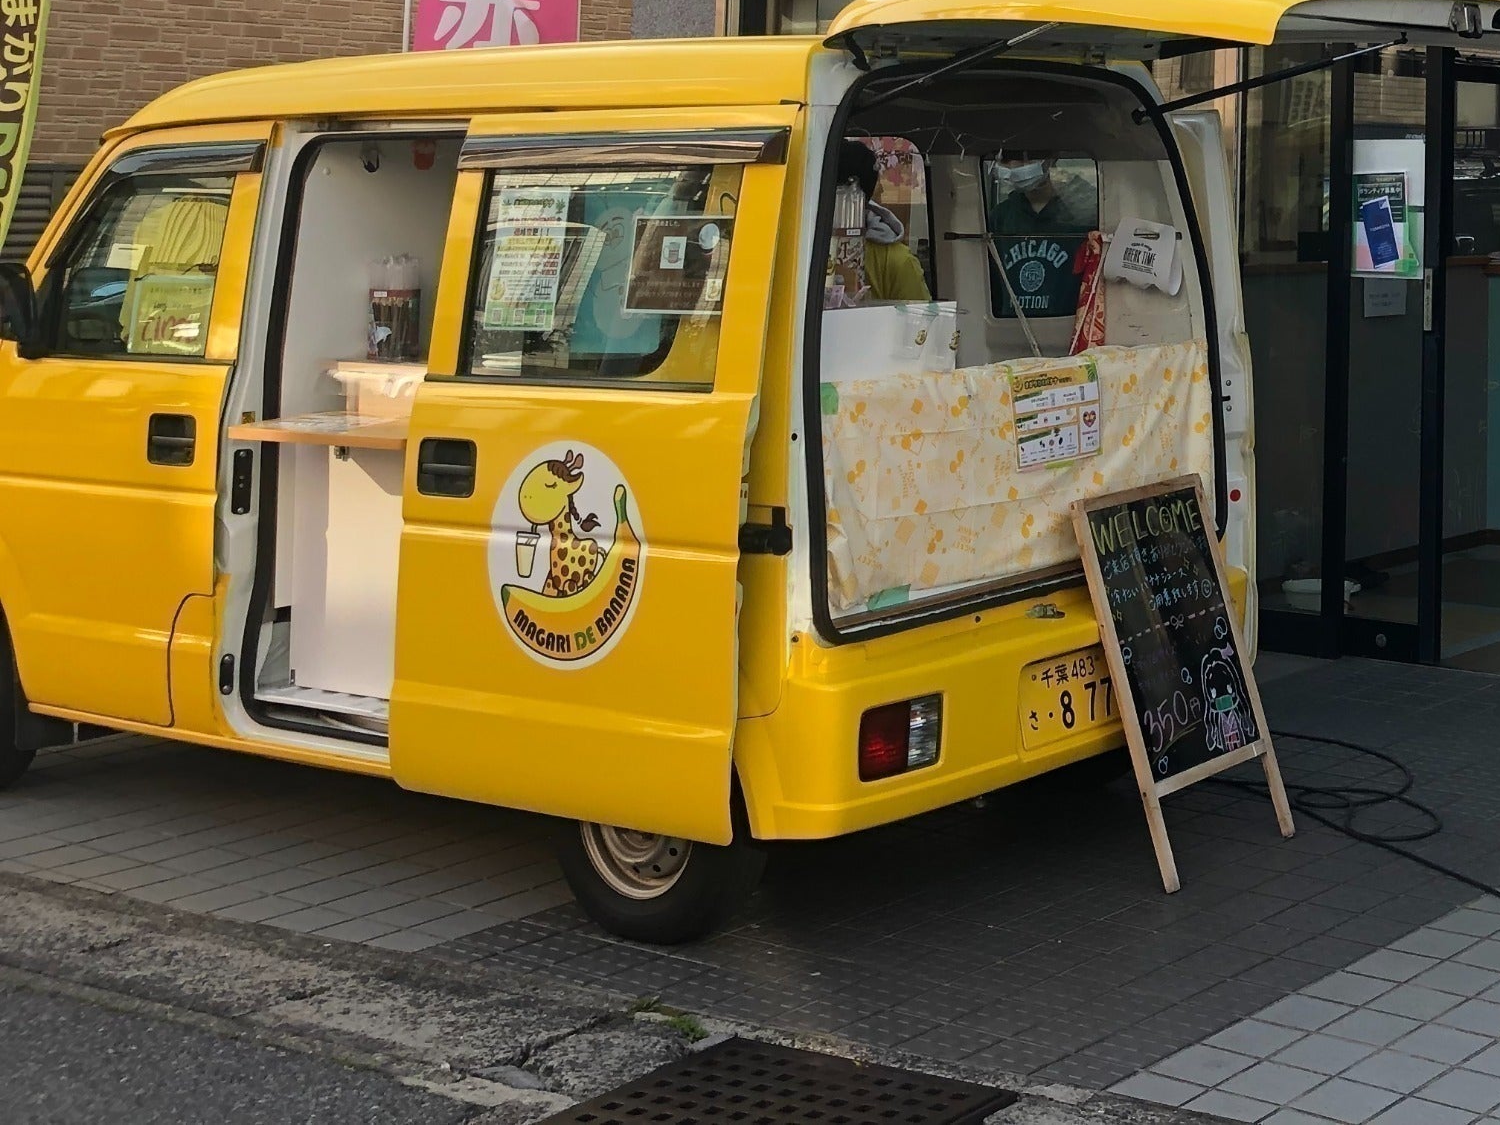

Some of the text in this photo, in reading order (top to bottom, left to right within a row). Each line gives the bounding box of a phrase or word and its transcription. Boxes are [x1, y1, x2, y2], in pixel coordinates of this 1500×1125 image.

[1002, 239, 1069, 271] CHICAGO
[1142, 250, 1157, 267] TIME
[1091, 499, 1202, 556] WELCOME
[513, 558, 636, 653] MAGARI DE BANANA
